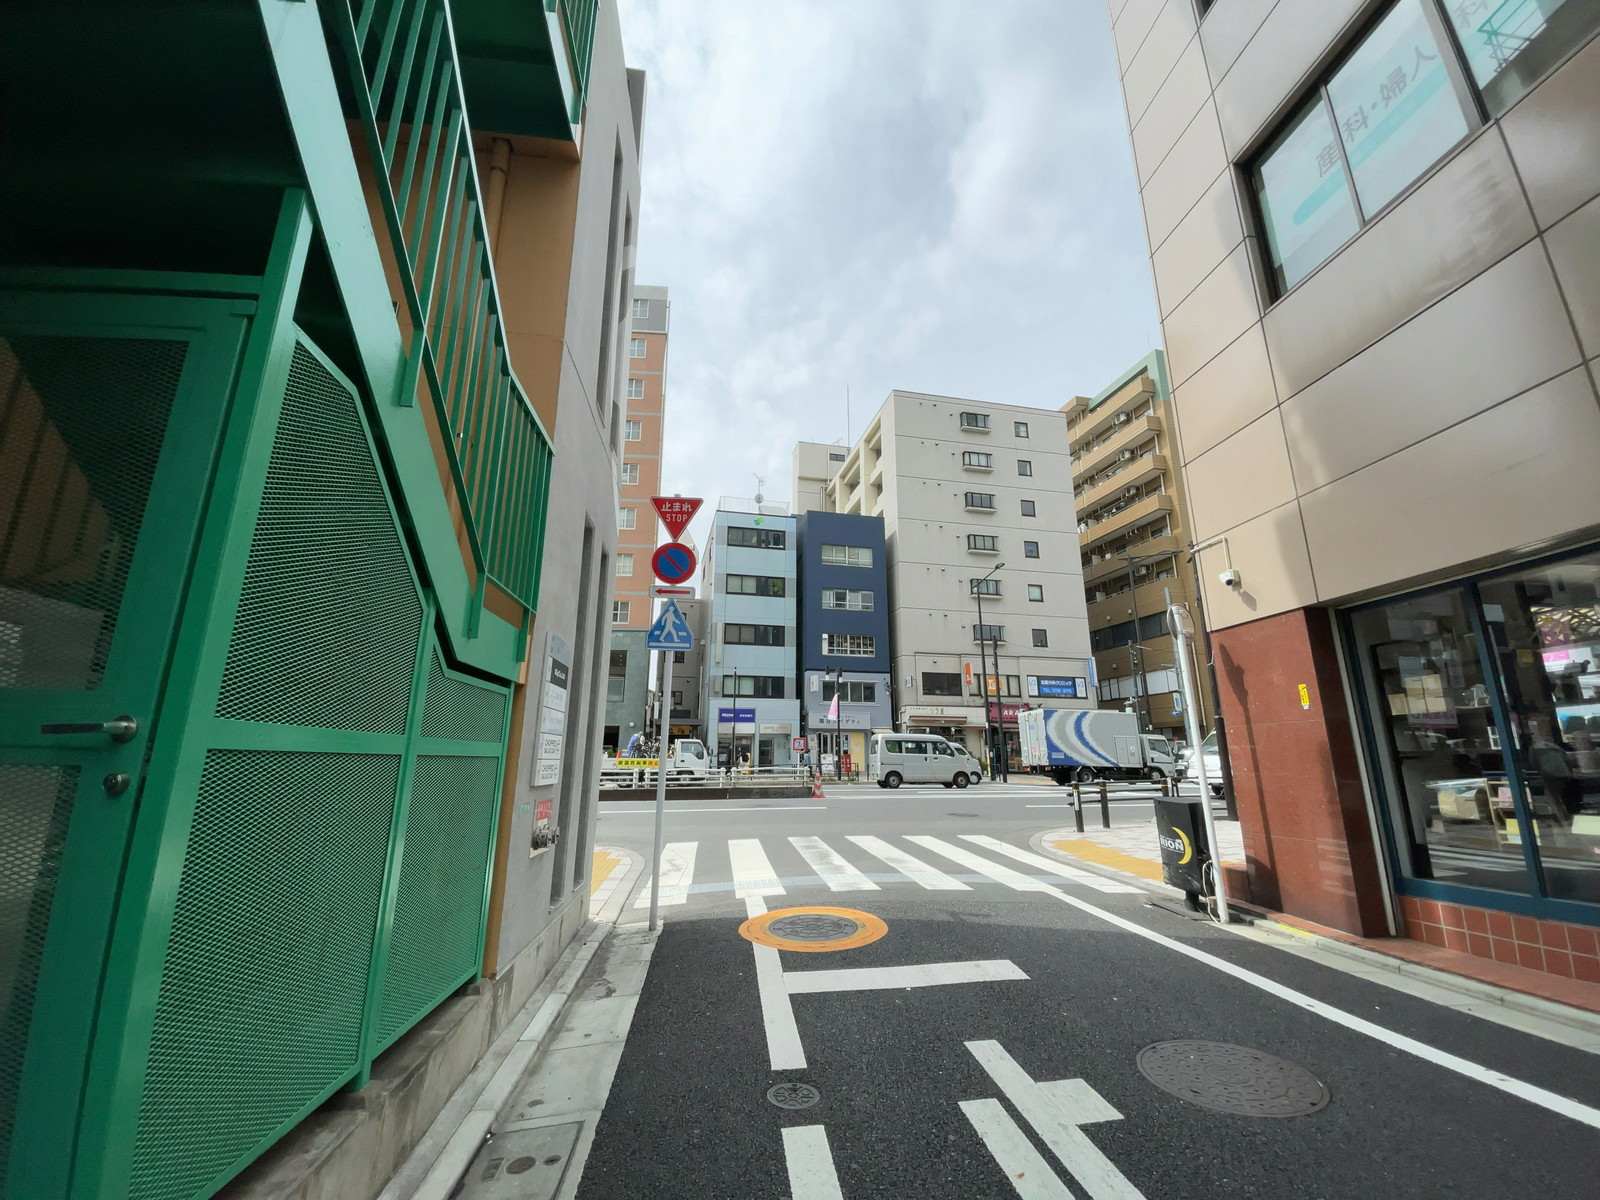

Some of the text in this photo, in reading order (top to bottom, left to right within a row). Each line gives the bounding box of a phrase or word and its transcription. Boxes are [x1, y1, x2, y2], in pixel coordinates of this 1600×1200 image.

[660, 501, 692, 512] 止まれ
[665, 513, 688, 523] STOP
